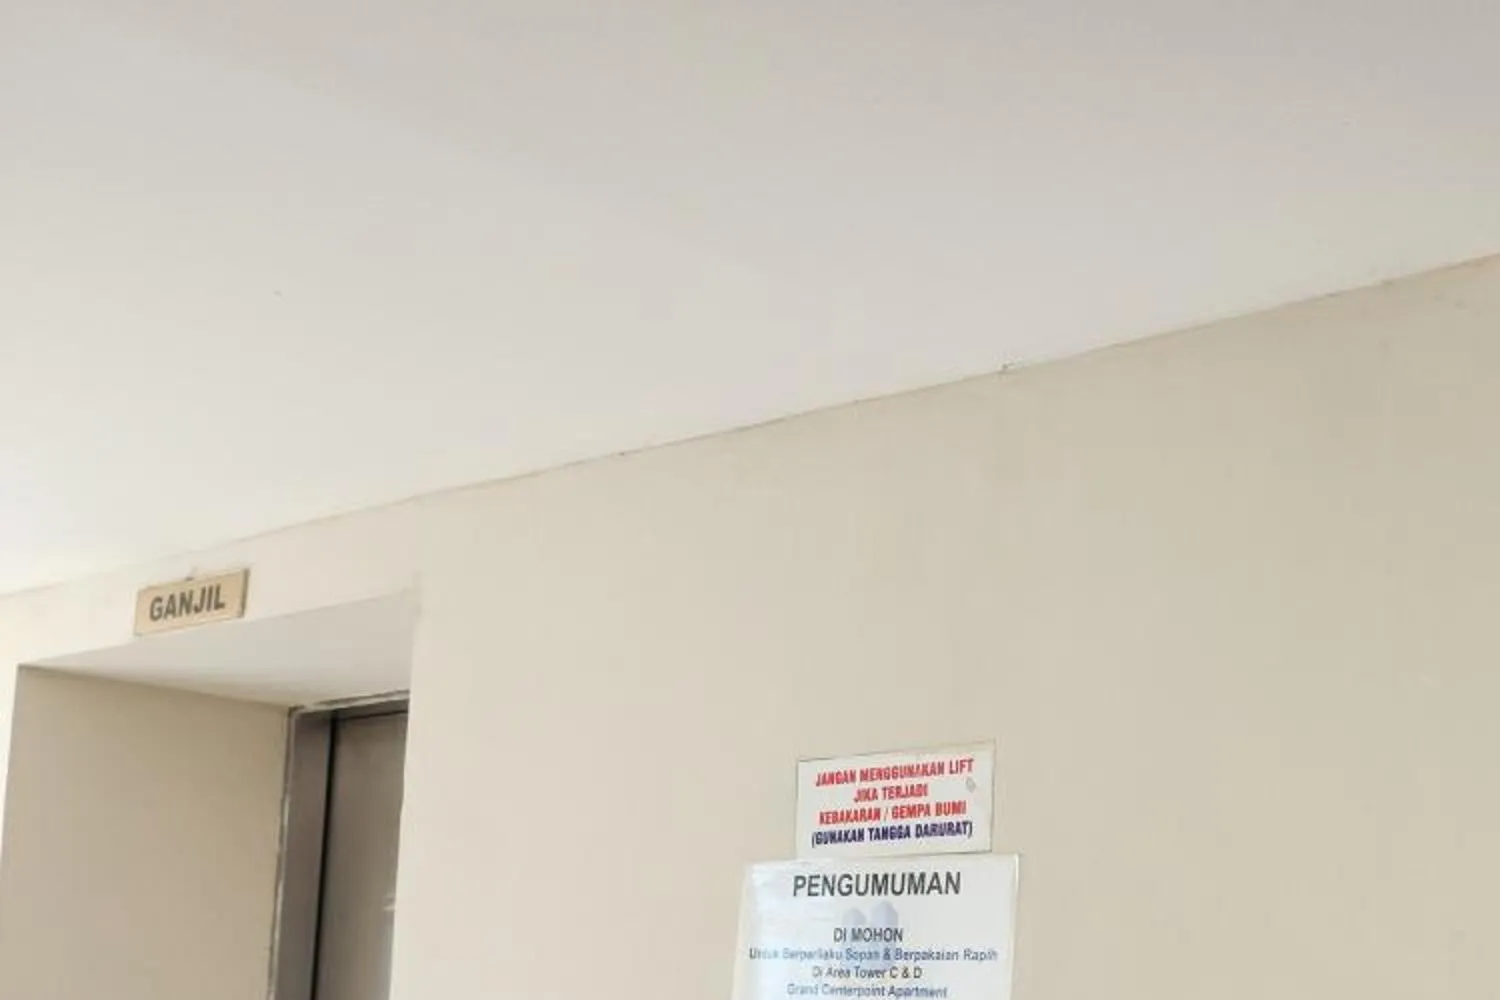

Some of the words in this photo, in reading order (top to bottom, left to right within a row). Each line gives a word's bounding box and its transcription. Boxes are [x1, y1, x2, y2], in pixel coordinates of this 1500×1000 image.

[149, 583, 226, 622] GANJIL
[815, 769, 857, 787] JANGAN
[859, 761, 945, 783] MENGGUNAKAN
[948, 758, 974, 775] LIFT
[853, 787, 879, 803] JIKA
[882, 783, 928, 801] TERJADI
[819, 806, 881, 825] KEBAKARAN
[891, 803, 931, 820] GEMPA
[935, 800, 967, 817] BUMI
[811, 827, 866, 848] (GUNAKAN
[868, 825, 911, 842] TANGGA
[914, 820, 974, 840] DARURAT)
[793, 871, 961, 897] PENGUMUMAN
[833, 927, 847, 942] DI
[850, 927, 904, 943] MOHON
[845, 947, 880, 962] Sopan
[883, 948, 892, 961] &
[894, 947, 959, 963] Berpakaian
[825, 966, 851, 978] Area
[854, 965, 887, 979] Tower
[889, 965, 899, 979] C
[901, 966, 911, 979] &
[913, 965, 923, 979] D
[787, 983, 819, 996] Grand
[821, 983, 885, 999] Centerpoint
[887, 985, 947, 1000] Apartment
